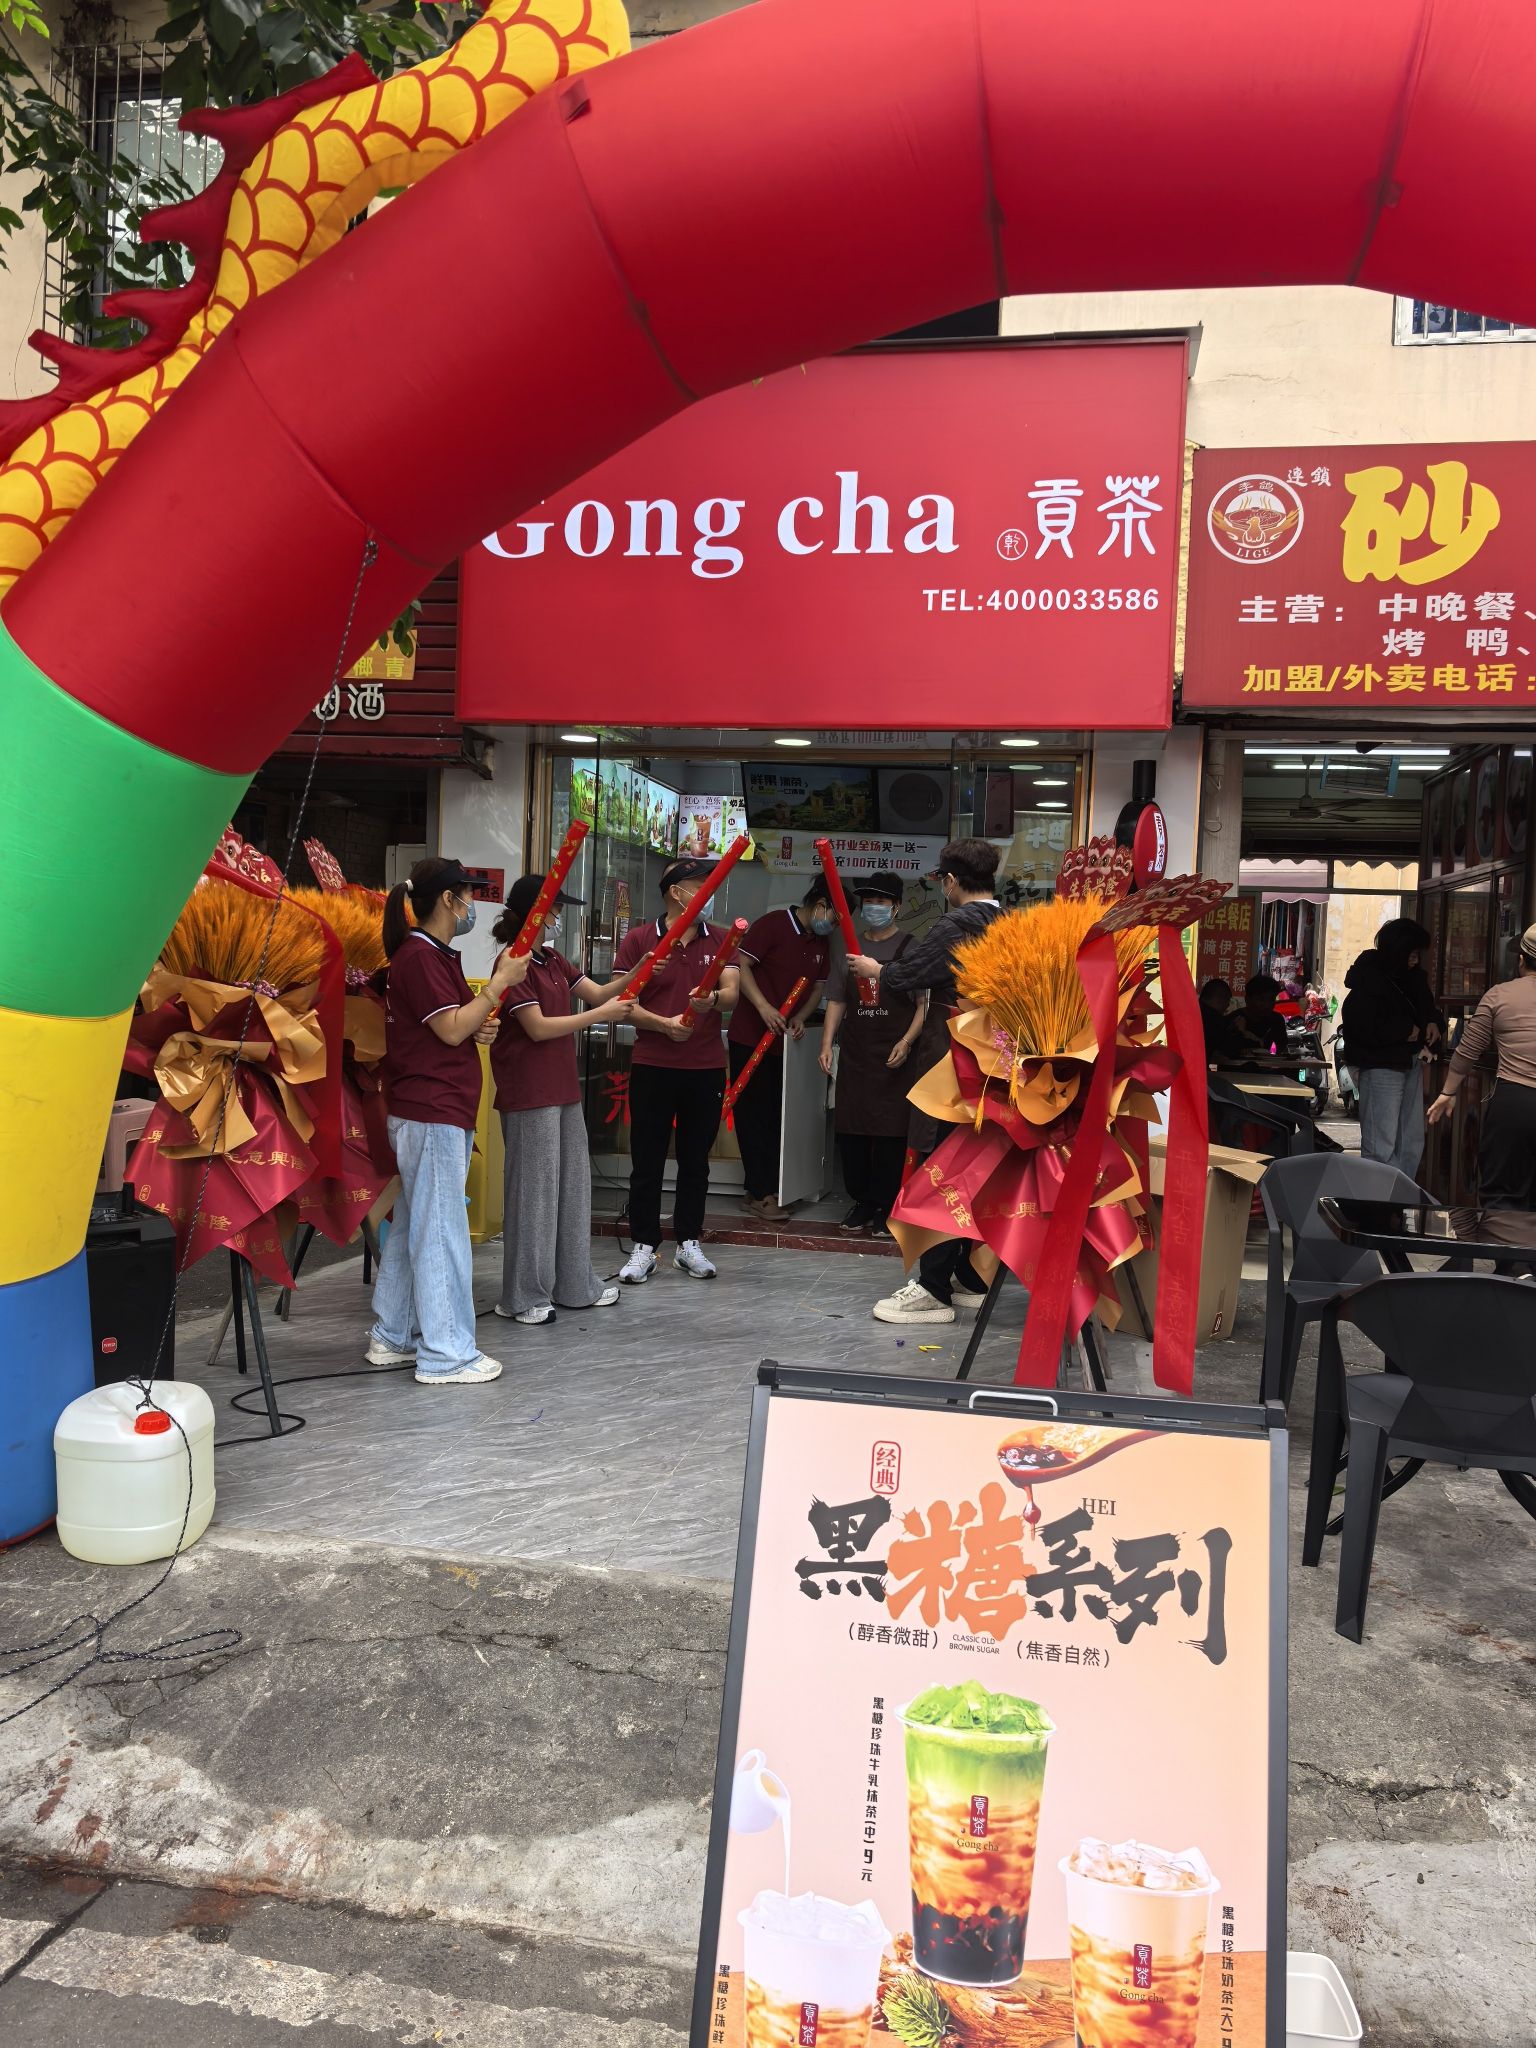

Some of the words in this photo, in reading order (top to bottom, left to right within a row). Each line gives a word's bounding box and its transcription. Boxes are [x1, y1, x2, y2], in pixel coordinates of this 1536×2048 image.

[777, 470, 960, 557] cha
[1028, 475, 1163, 560] 貢茶
[1340, 460, 1501, 586] 砂
[923, 587, 1160, 612] TEL:4000033586
[812, 838, 928, 854] 开业全场买一送一
[812, 854, 921, 871] 会充100元送100元
[875, 1447, 897, 1491] 经典
[1082, 1497, 1117, 1516] HEI
[795, 1482, 1233, 1666] 黑糖系列
[949, 1643, 975, 1652] BROWN
[977, 1645, 1000, 1655] SUGAR
[952, 1634, 979, 1644] CLASSIC
[981, 1636, 996, 1645] OLD
[957, 1838, 981, 1852] Gong
[983, 1841, 999, 1851] cha
[1120, 1989, 1146, 2004] Gong
[1148, 1992, 1164, 2003] cha
